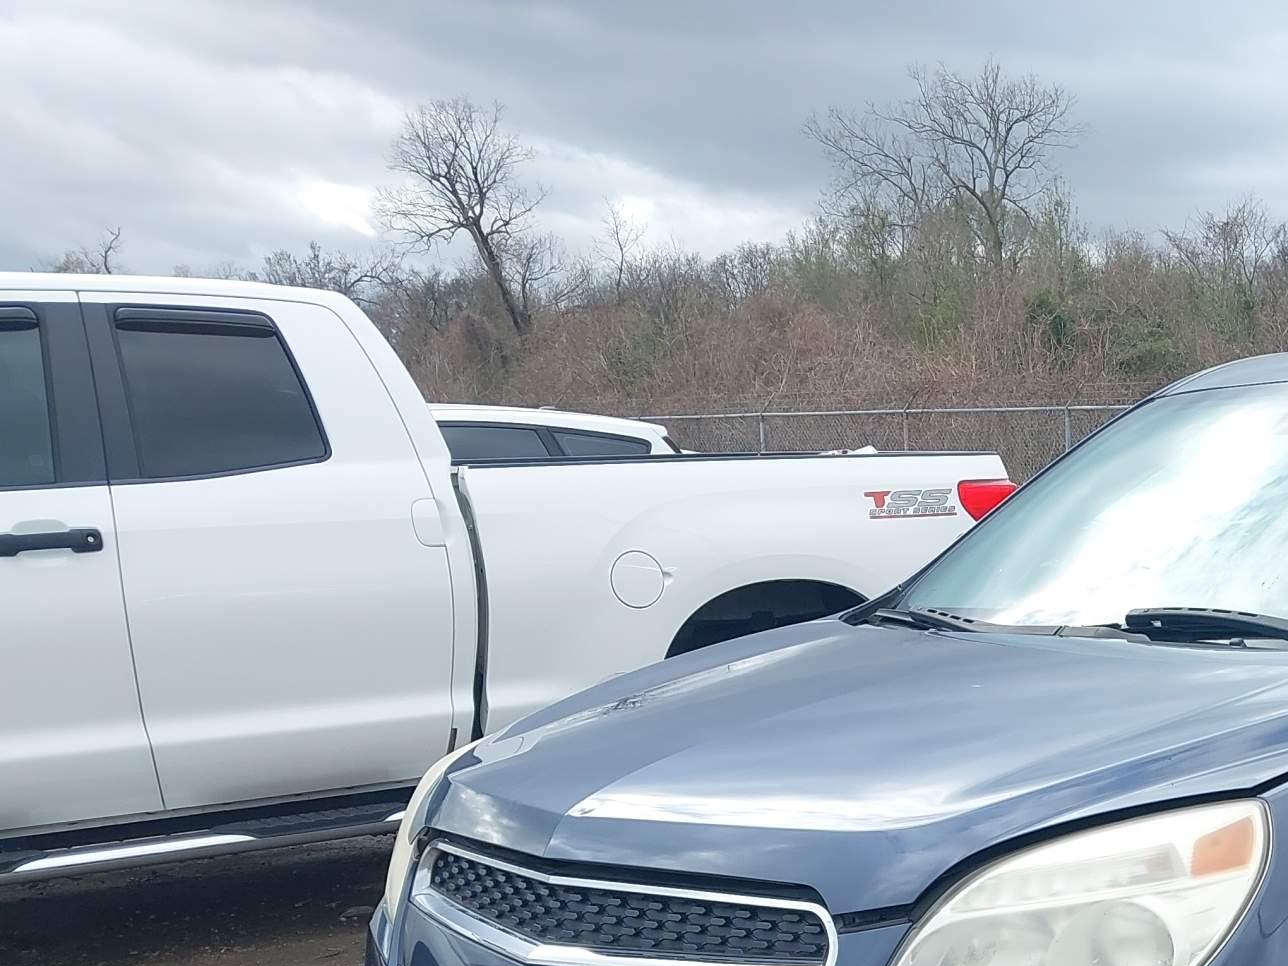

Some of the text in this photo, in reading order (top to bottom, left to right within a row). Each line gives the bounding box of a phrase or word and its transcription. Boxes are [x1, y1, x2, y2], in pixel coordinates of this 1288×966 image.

[863, 488, 953, 509] TSS
[869, 505, 956, 516] SPORT SERIES
